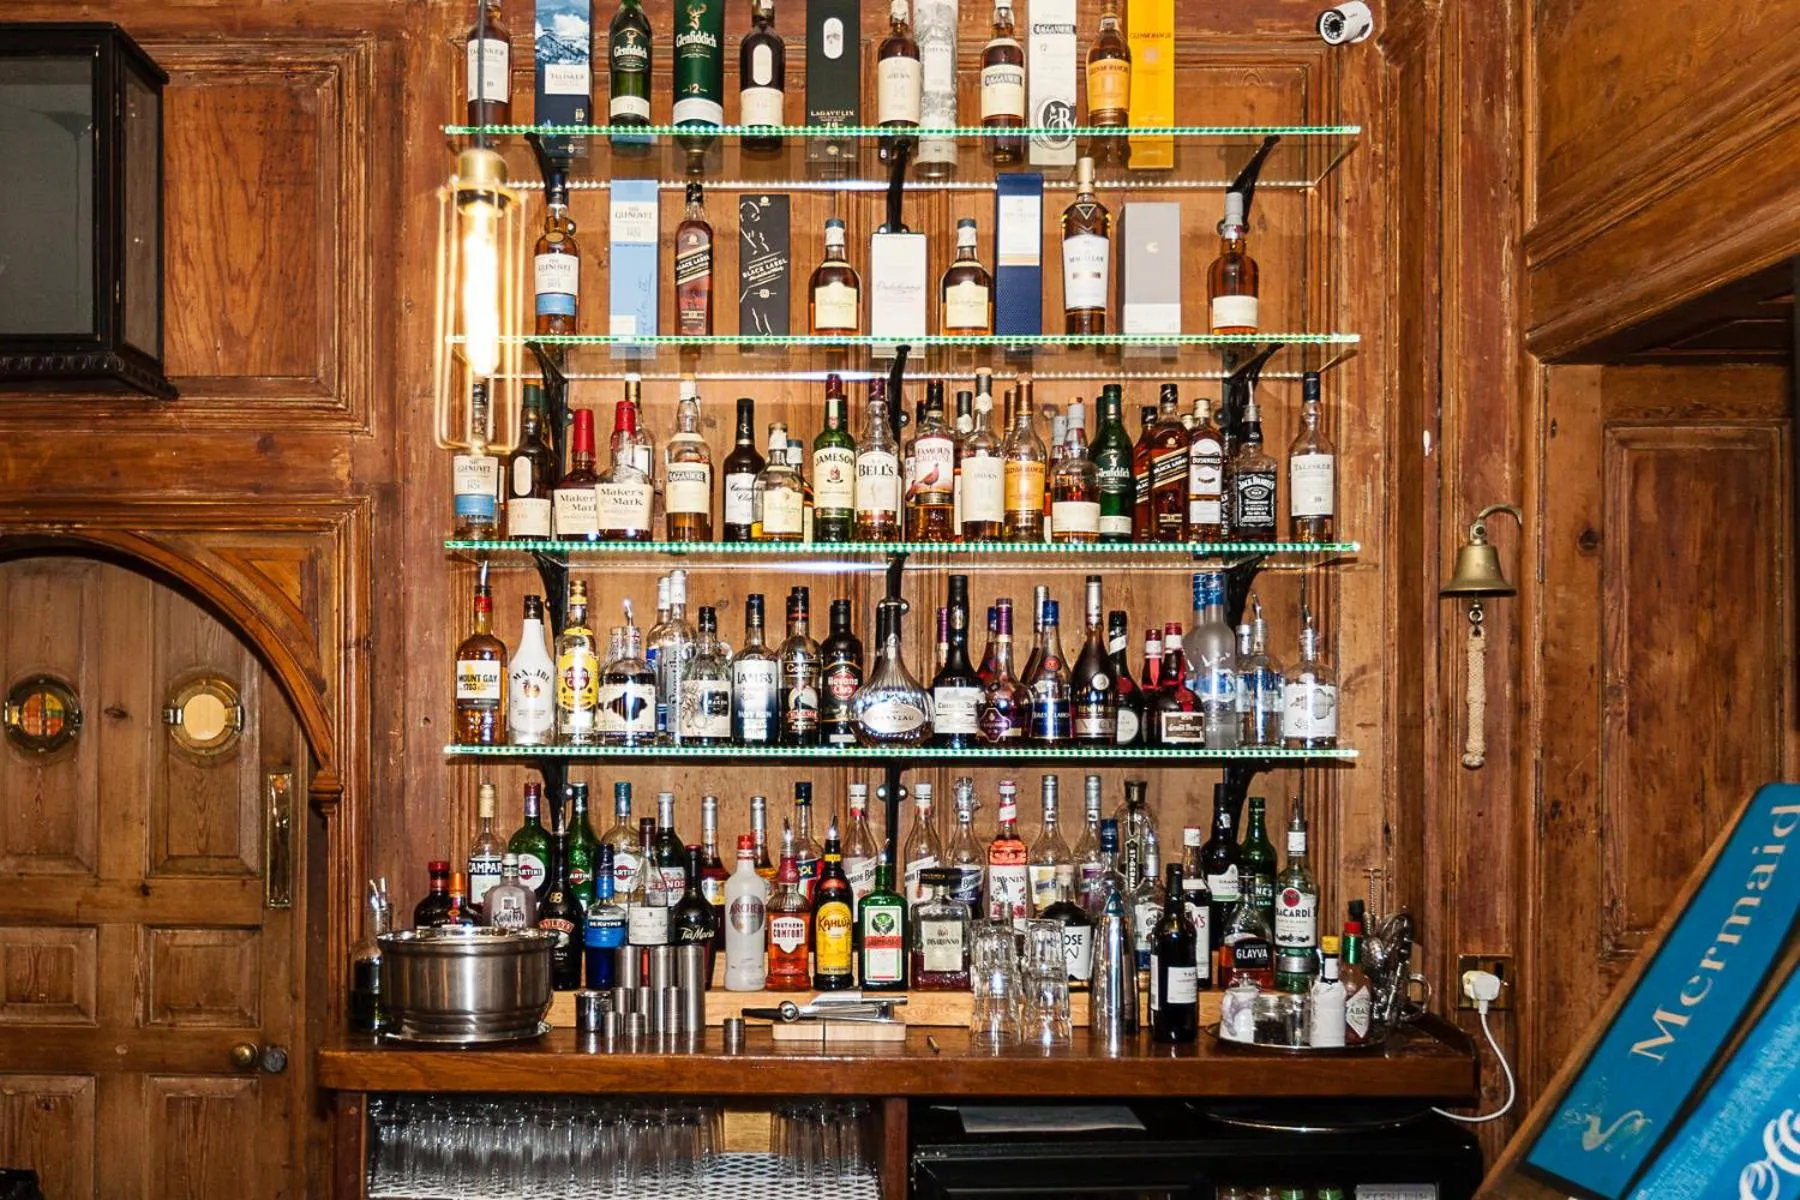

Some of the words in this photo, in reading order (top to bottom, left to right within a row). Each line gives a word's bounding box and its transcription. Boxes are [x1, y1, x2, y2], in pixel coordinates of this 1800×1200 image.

[676, 31, 717, 47] Glenfiddich
[743, 264, 766, 279] BLACK
[766, 258, 788, 272] LABEL
[815, 452, 854, 468] JAMESON
[858, 463, 894, 480] BELL'S
[600, 487, 644, 498] Maker's
[559, 494, 596, 504] Maker
[612, 497, 643, 507] Mark
[458, 674, 481, 683] MOUNT
[482, 674, 498, 683] GAY
[468, 861, 503, 874] CAMPAR
[518, 867, 544, 878] ARTINI
[773, 928, 804, 940] COMFORT
[1628, 803, 1800, 1067] Mermaid
[1236, 948, 1268, 959] GLAYVA
